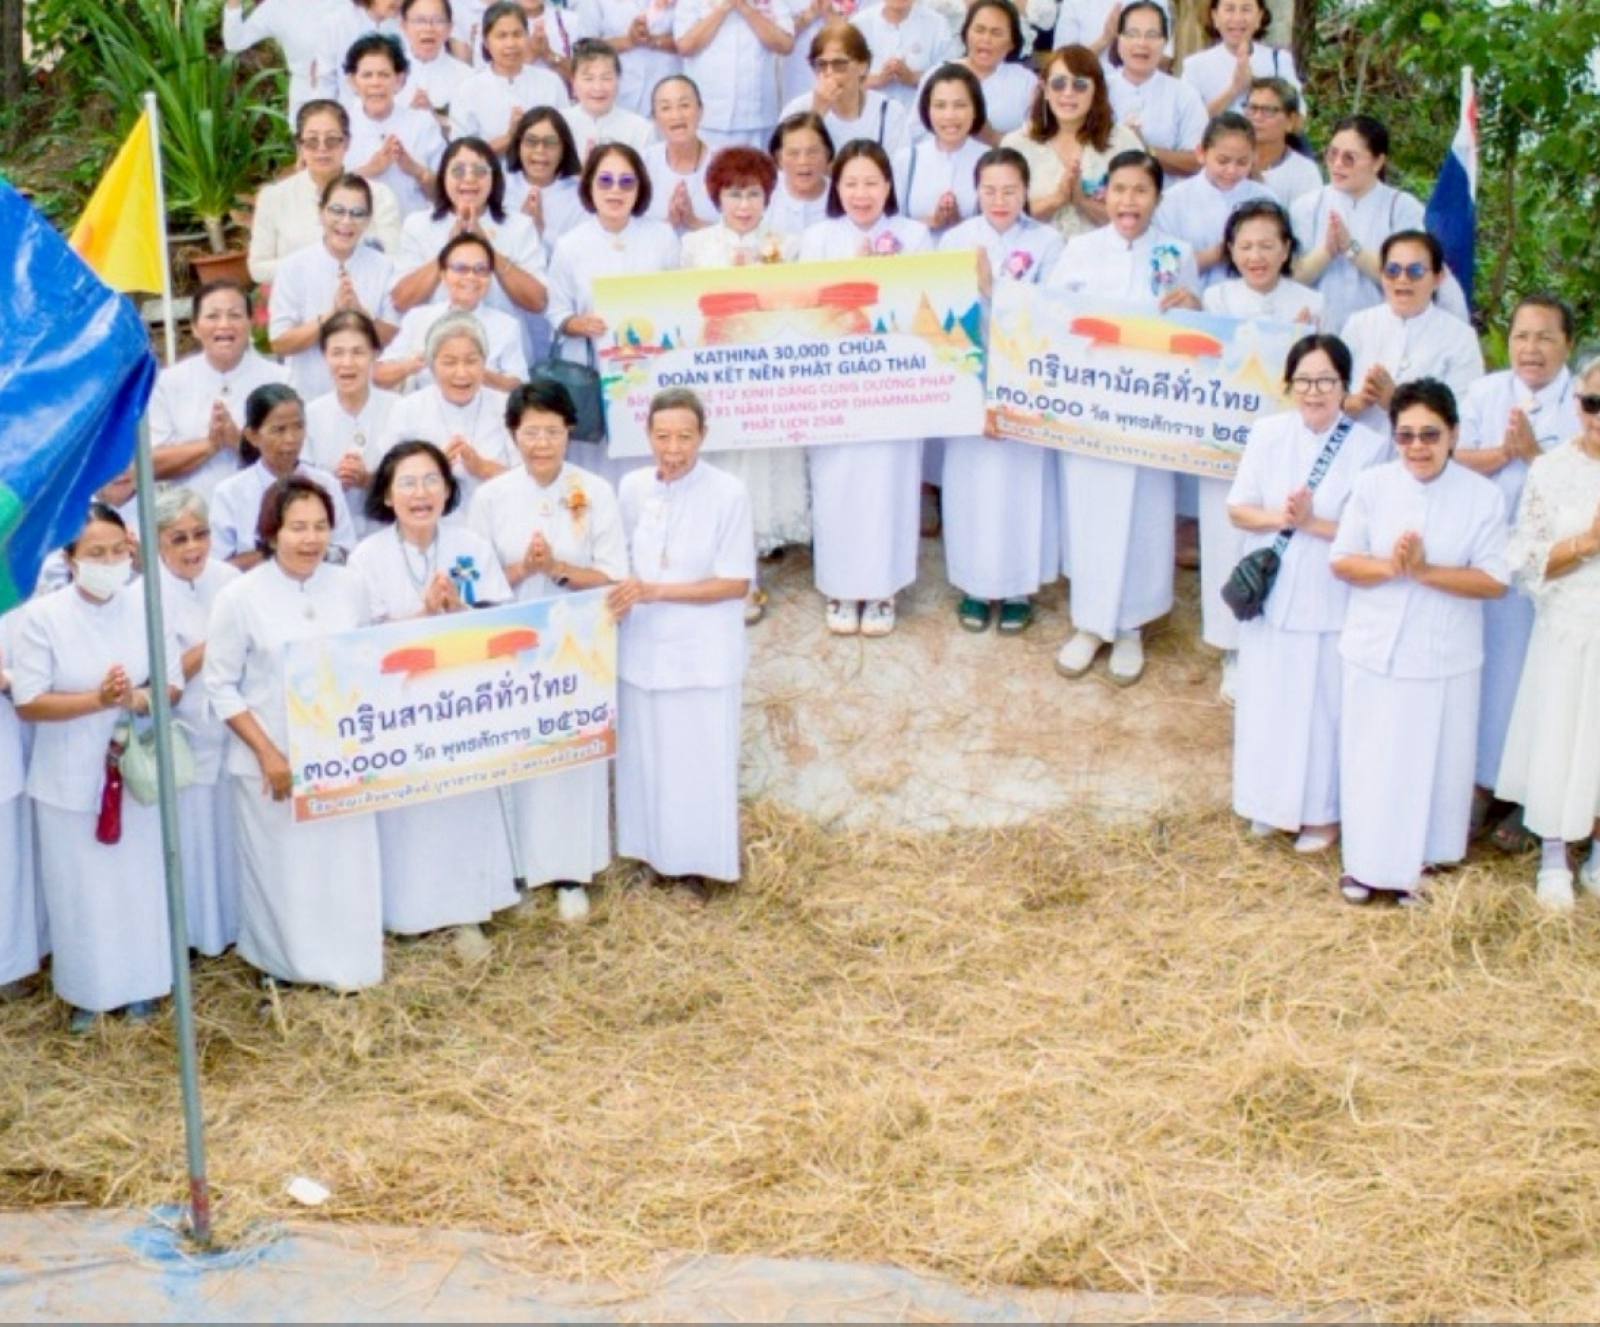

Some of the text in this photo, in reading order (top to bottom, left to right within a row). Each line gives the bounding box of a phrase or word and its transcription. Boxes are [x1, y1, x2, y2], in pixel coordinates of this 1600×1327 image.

[657, 368, 709, 387] ĐOÀN
[838, 357, 881, 374] GIÁO
[886, 352, 927, 371] THÁI
[693, 337, 887, 365] KATHINA 30,000 CHÙA
[1028, 353, 1259, 412] กฐินสามัคคีทั่วไทย
[1212, 422, 1251, 446] ๒๕
[338, 670, 577, 745] กฐินสามัคคีทั่วไทย
[303, 748, 407, 780] ๓๐,๐๐๐
[537, 701, 609, 736] ๒๕๖๘
